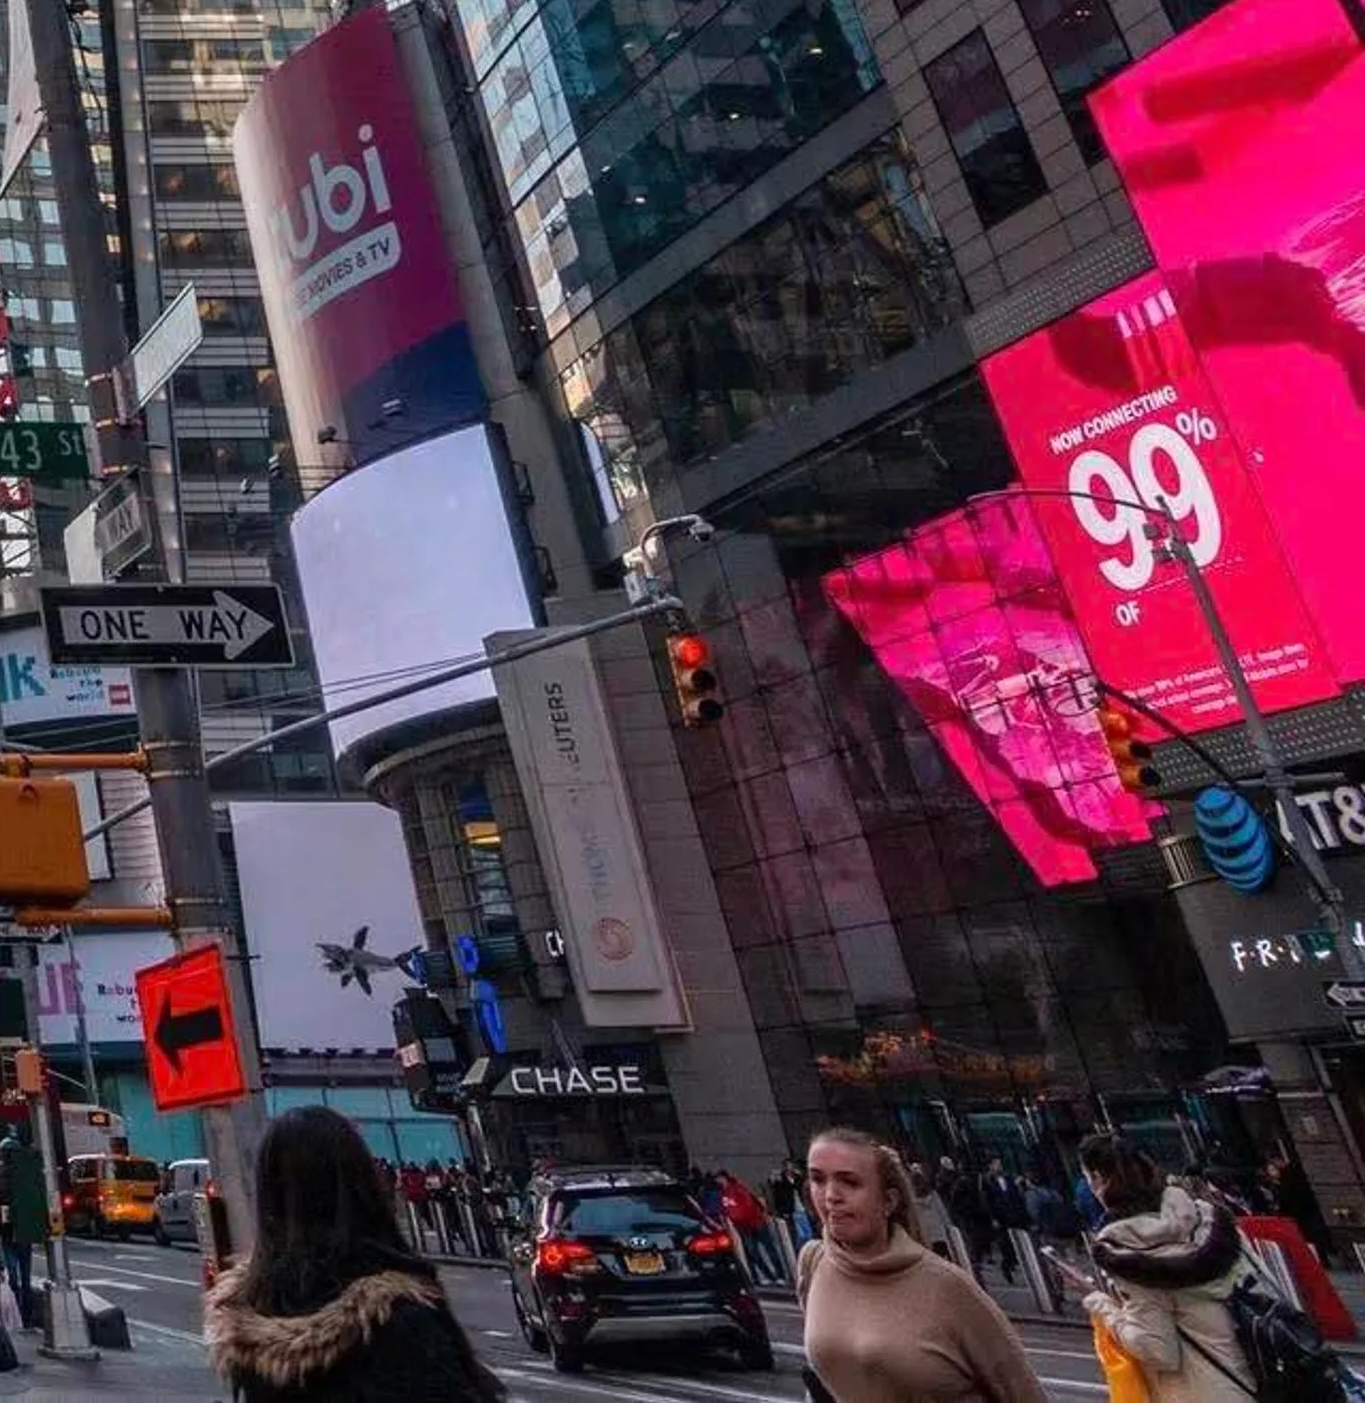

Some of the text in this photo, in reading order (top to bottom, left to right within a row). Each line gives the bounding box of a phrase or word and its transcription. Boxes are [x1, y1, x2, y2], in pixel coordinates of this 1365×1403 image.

[270, 124, 393, 260] ubi
[369, 237, 391, 262] TV
[1049, 385, 1179, 455] NOW CONNECTING
[0, 429, 43, 471] 43
[57, 430, 83, 456] St
[81, 610, 248, 641] ONE WAY
[1114, 600, 1143, 627] OF
[544, 682, 580, 768] EUTERS
[511, 1065, 645, 1095] CHASE
